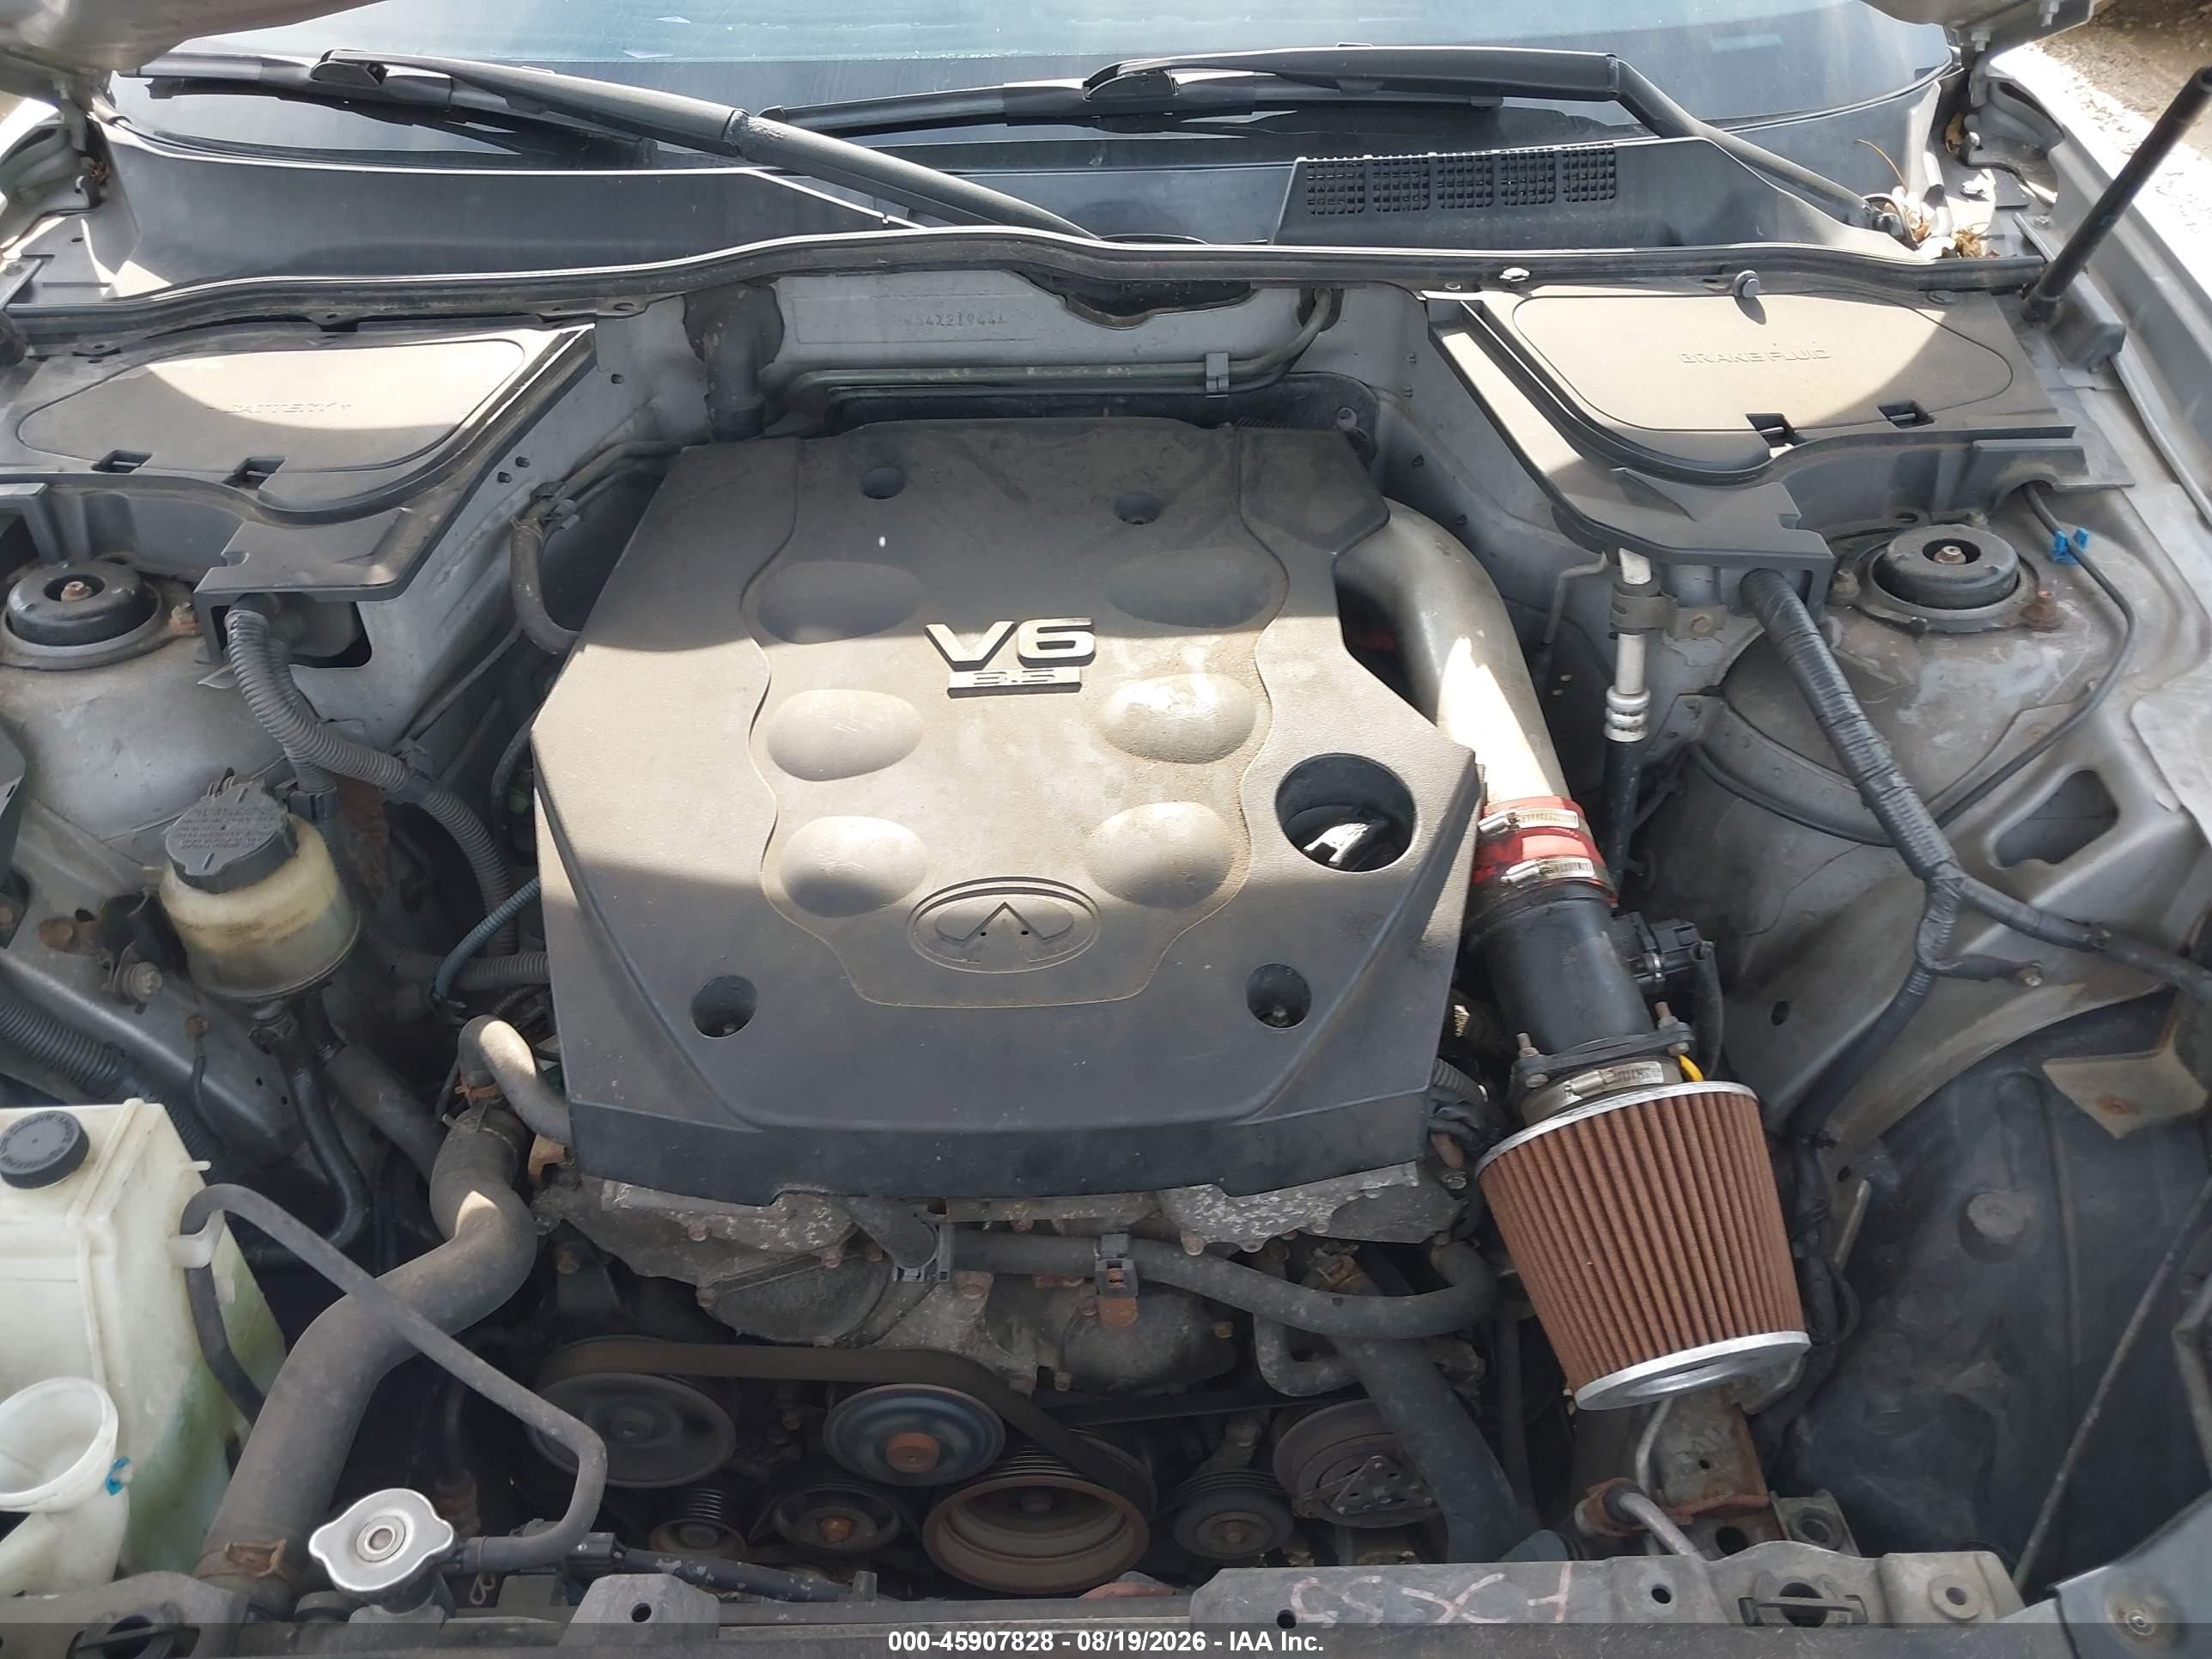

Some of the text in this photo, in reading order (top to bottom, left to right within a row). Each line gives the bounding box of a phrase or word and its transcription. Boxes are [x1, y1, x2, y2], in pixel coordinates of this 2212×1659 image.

[1677, 349, 1832, 364] BRAKE FLUID
[924, 617, 1097, 672] V6
[972, 668, 1057, 686] 3.5
